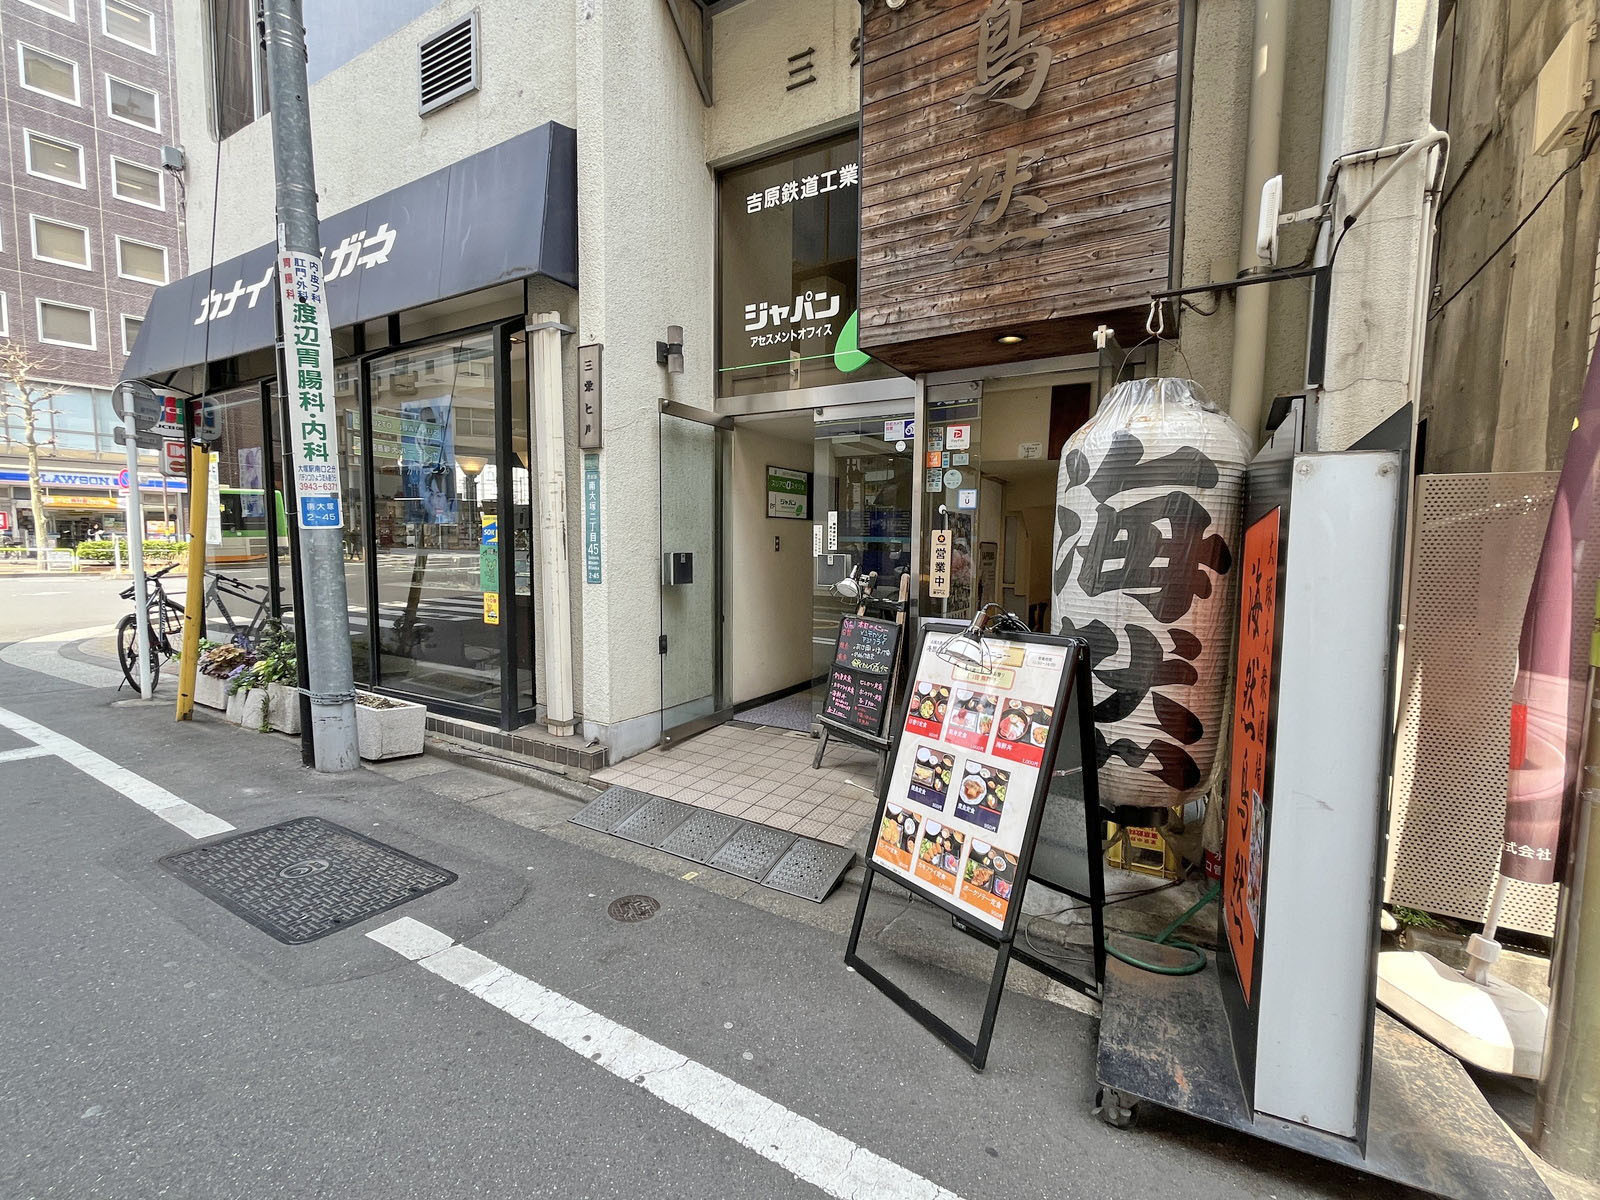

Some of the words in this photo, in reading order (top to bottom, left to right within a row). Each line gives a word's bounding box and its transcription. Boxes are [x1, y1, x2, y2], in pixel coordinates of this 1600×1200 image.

[746, 163, 859, 214] 吉原鉄道工業
[193, 222, 397, 326] カナイガネ
[744, 290, 840, 332] ジャパン
[750, 323, 833, 349] アセスメントオフィス
[292, 302, 330, 463] 渡辺胃腸科・内科
[40, 473, 110, 486] LAWSON
[299, 482, 338, 491] 3943-6371
[587, 543, 599, 555] 45
[934, 547, 947, 588] 営業中
